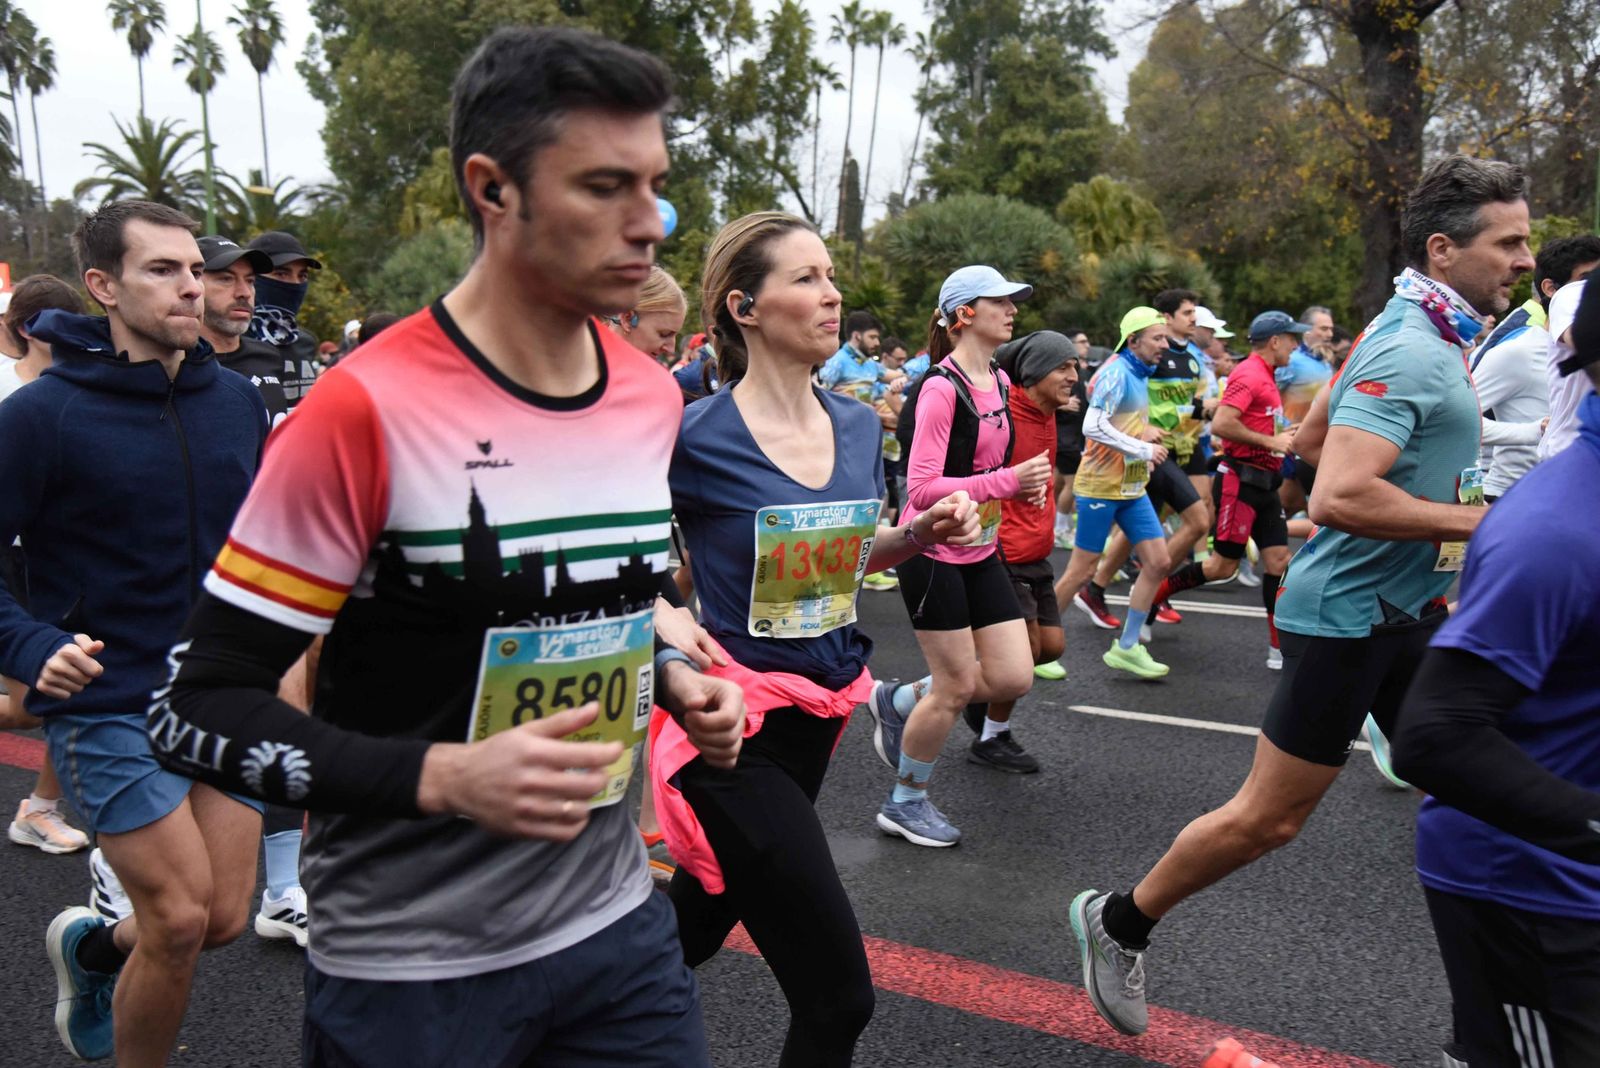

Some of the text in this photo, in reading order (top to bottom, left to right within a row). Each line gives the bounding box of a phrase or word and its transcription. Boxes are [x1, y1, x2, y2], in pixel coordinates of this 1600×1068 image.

[465, 458, 514, 470] SPALL
[807, 506, 847, 518] maratón
[815, 515, 847, 527] sevilla
[770, 535, 862, 581] 13133
[563, 624, 620, 645] maratón
[511, 667, 628, 727] 8580
